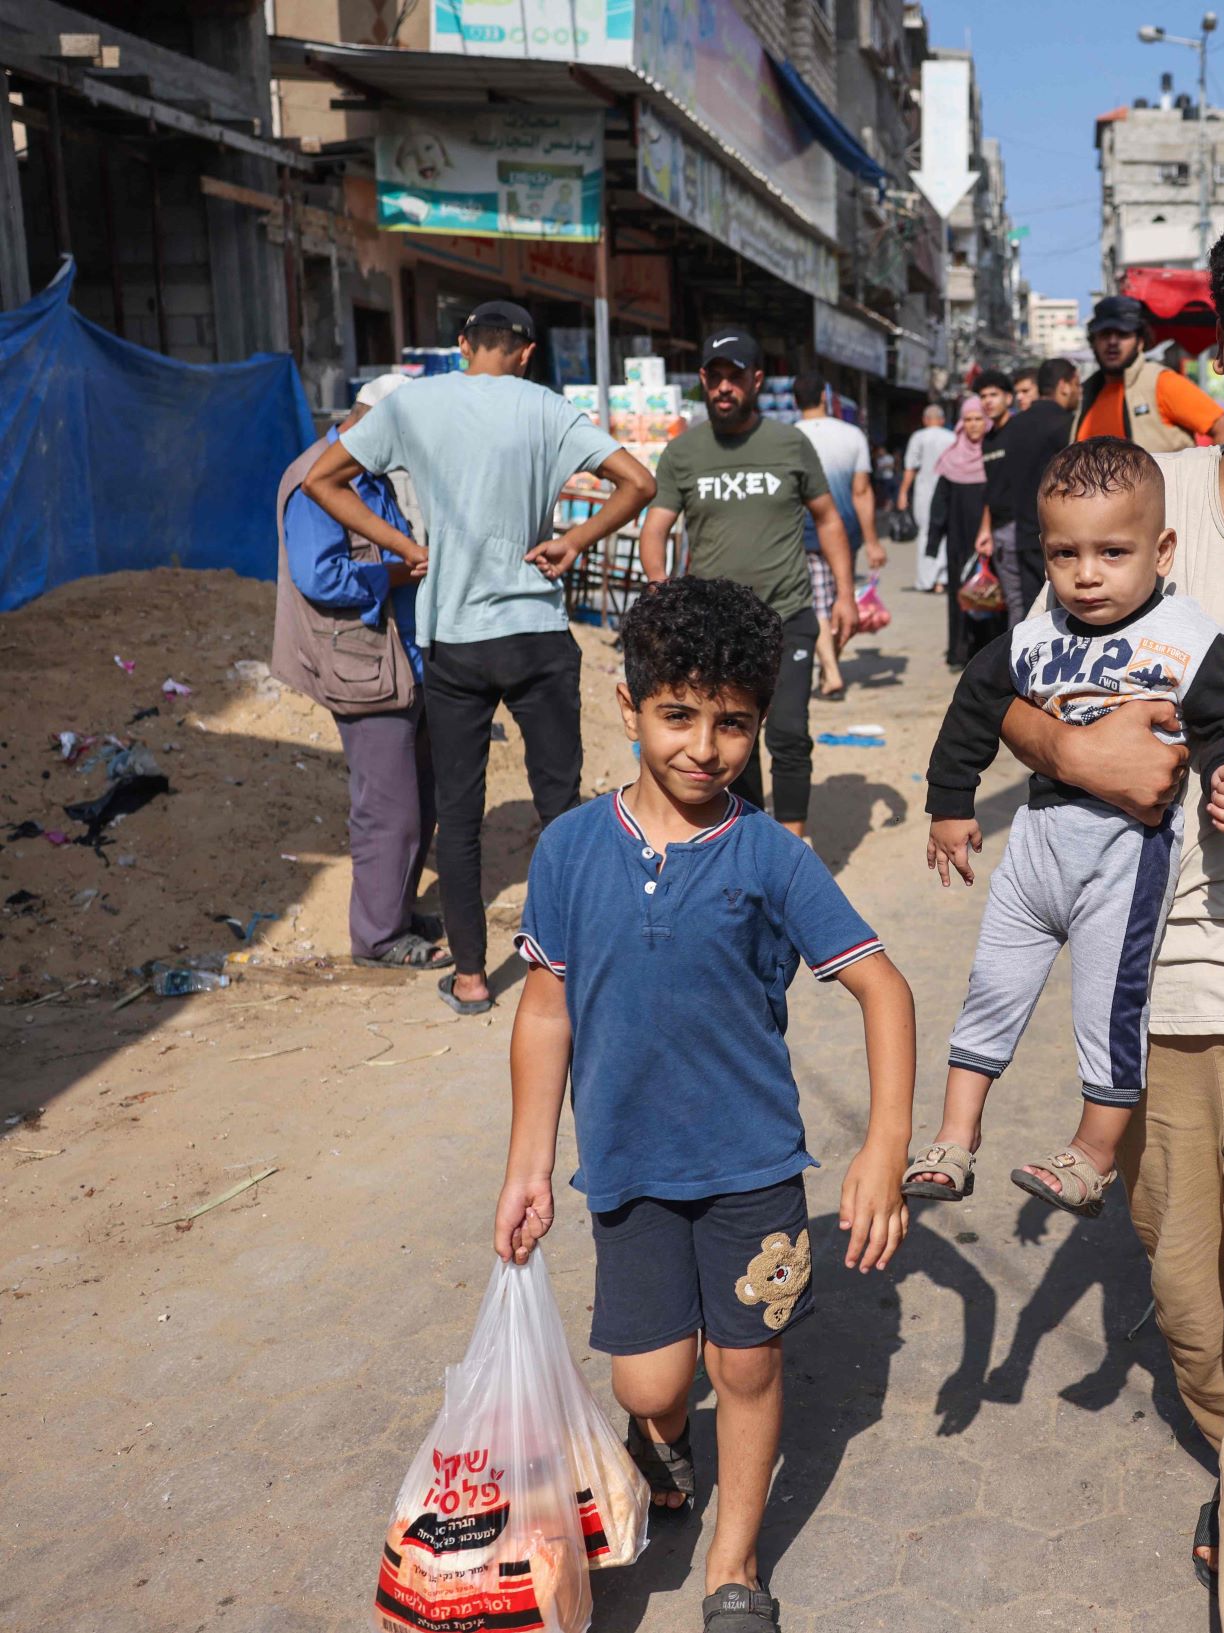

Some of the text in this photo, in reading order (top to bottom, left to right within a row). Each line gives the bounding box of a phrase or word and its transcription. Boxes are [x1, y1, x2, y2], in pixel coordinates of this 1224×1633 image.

[697, 472, 781, 501] FIXED
[1166, 647, 1188, 662] FORCE
[1100, 676, 1118, 691] TWO
[448, 1517, 476, 1531] חברה
